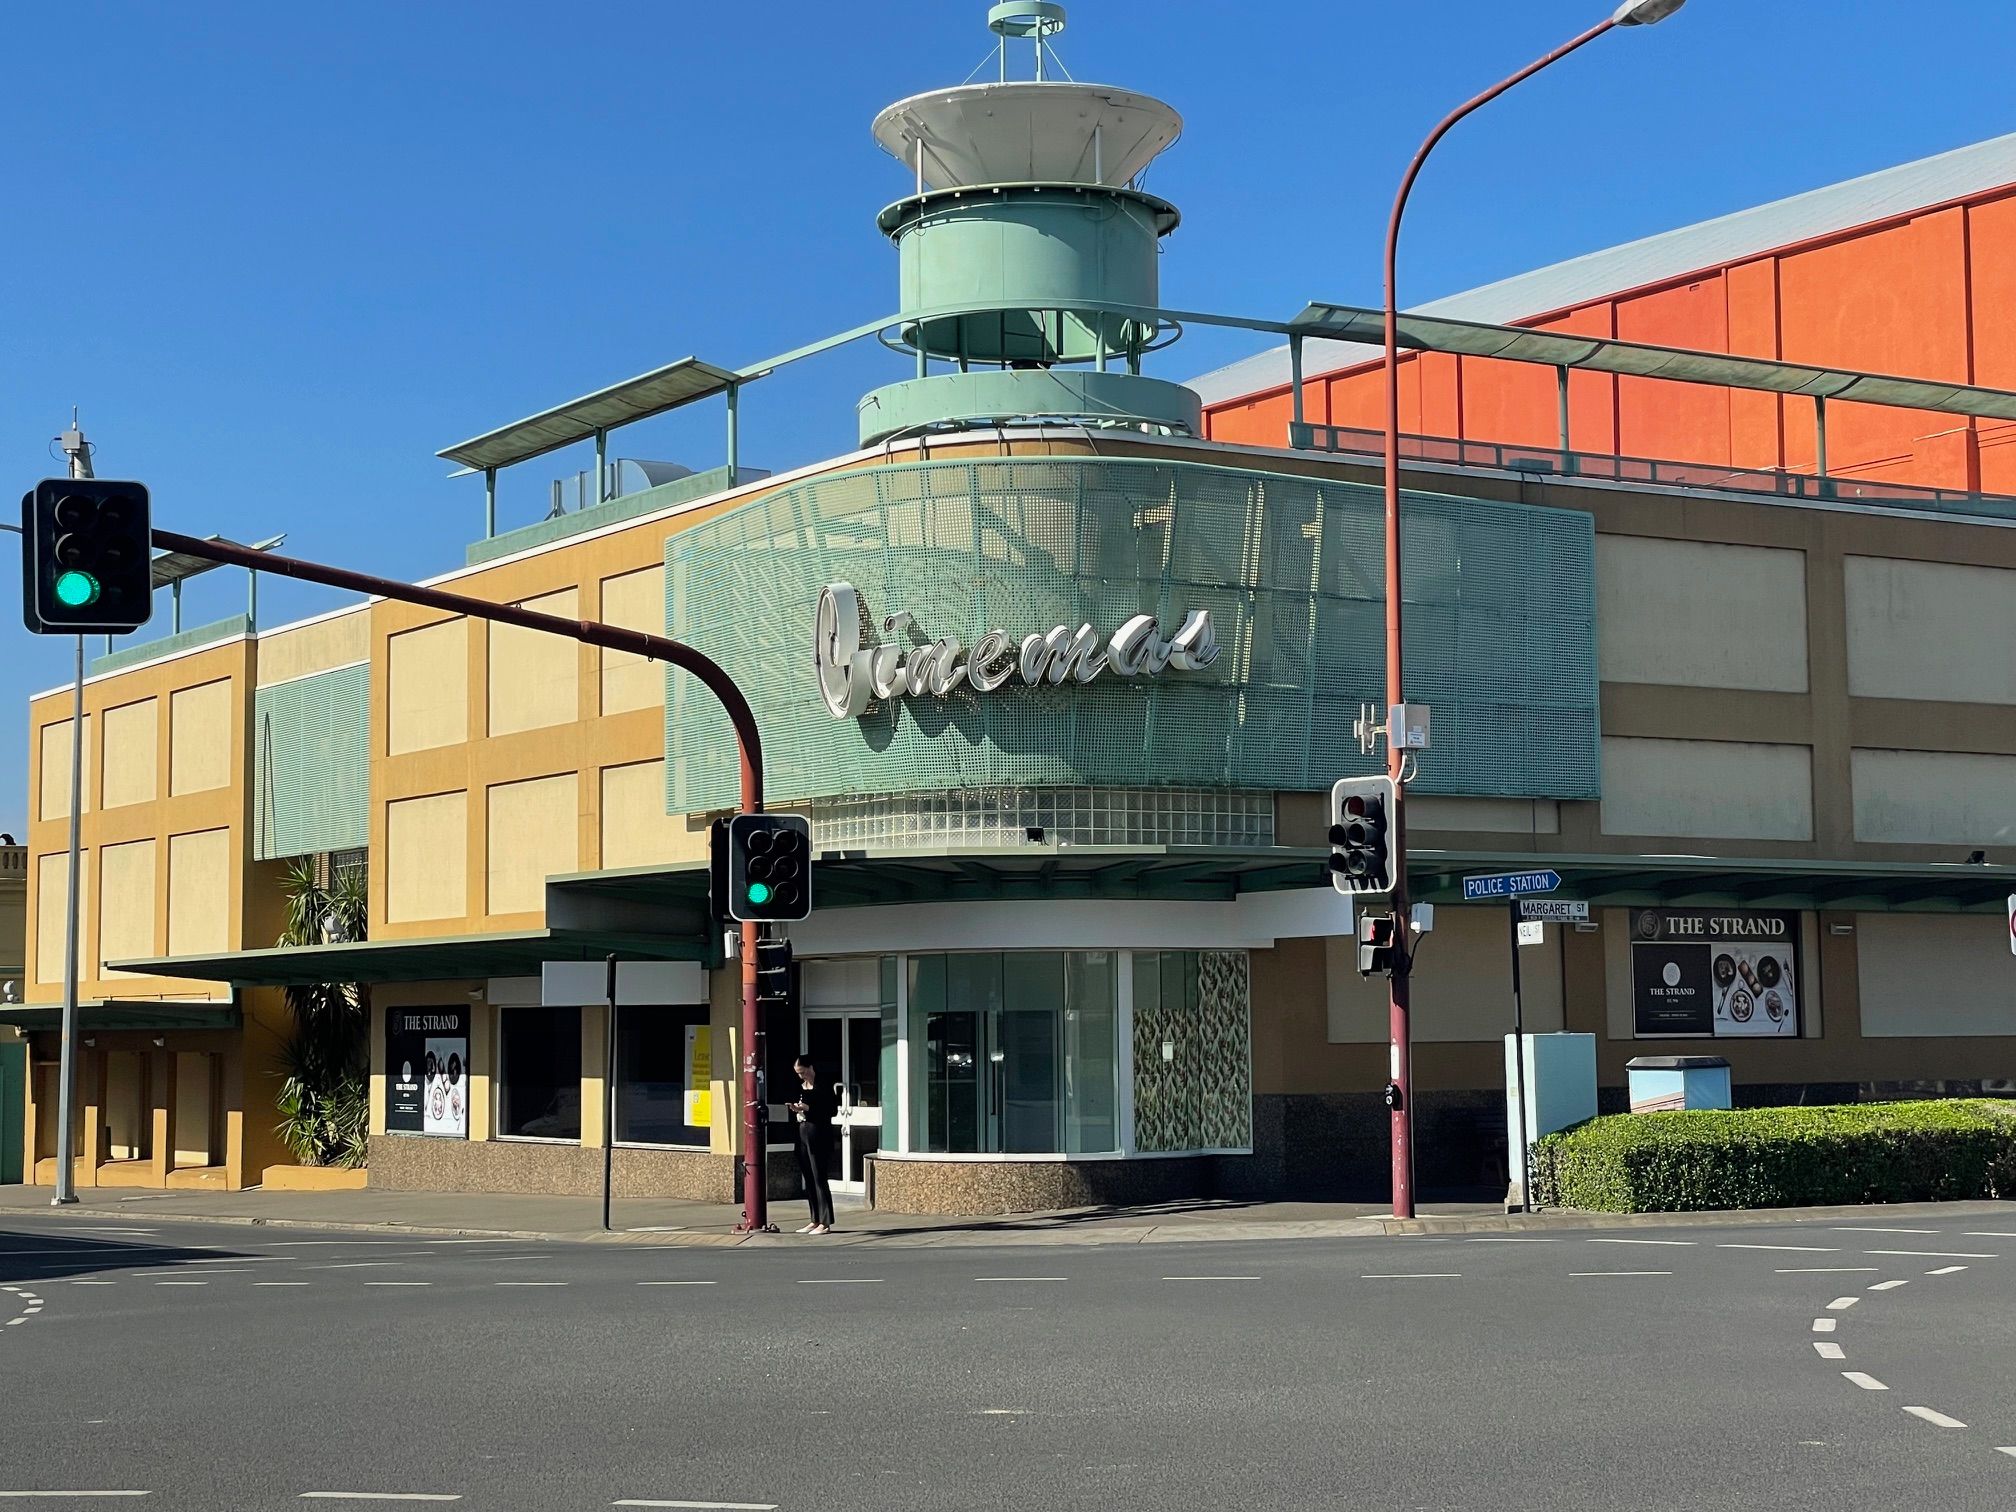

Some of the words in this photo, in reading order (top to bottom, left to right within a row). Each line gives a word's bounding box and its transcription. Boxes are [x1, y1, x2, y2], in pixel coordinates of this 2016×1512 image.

[814, 581, 1221, 719] Cinemas
[1468, 878, 1504, 895] POLICE
[1510, 874, 1549, 892] STATION
[1523, 903, 1571, 915] MARGARET
[1577, 904, 1585, 912] ST
[1667, 917, 1704, 934] THE
[1710, 918, 1785, 935] STRAND
[1650, 988, 1664, 996] THE
[1666, 988, 1695, 996] STRAND
[404, 1015, 420, 1030] THE
[423, 1015, 458, 1030] STRAND
